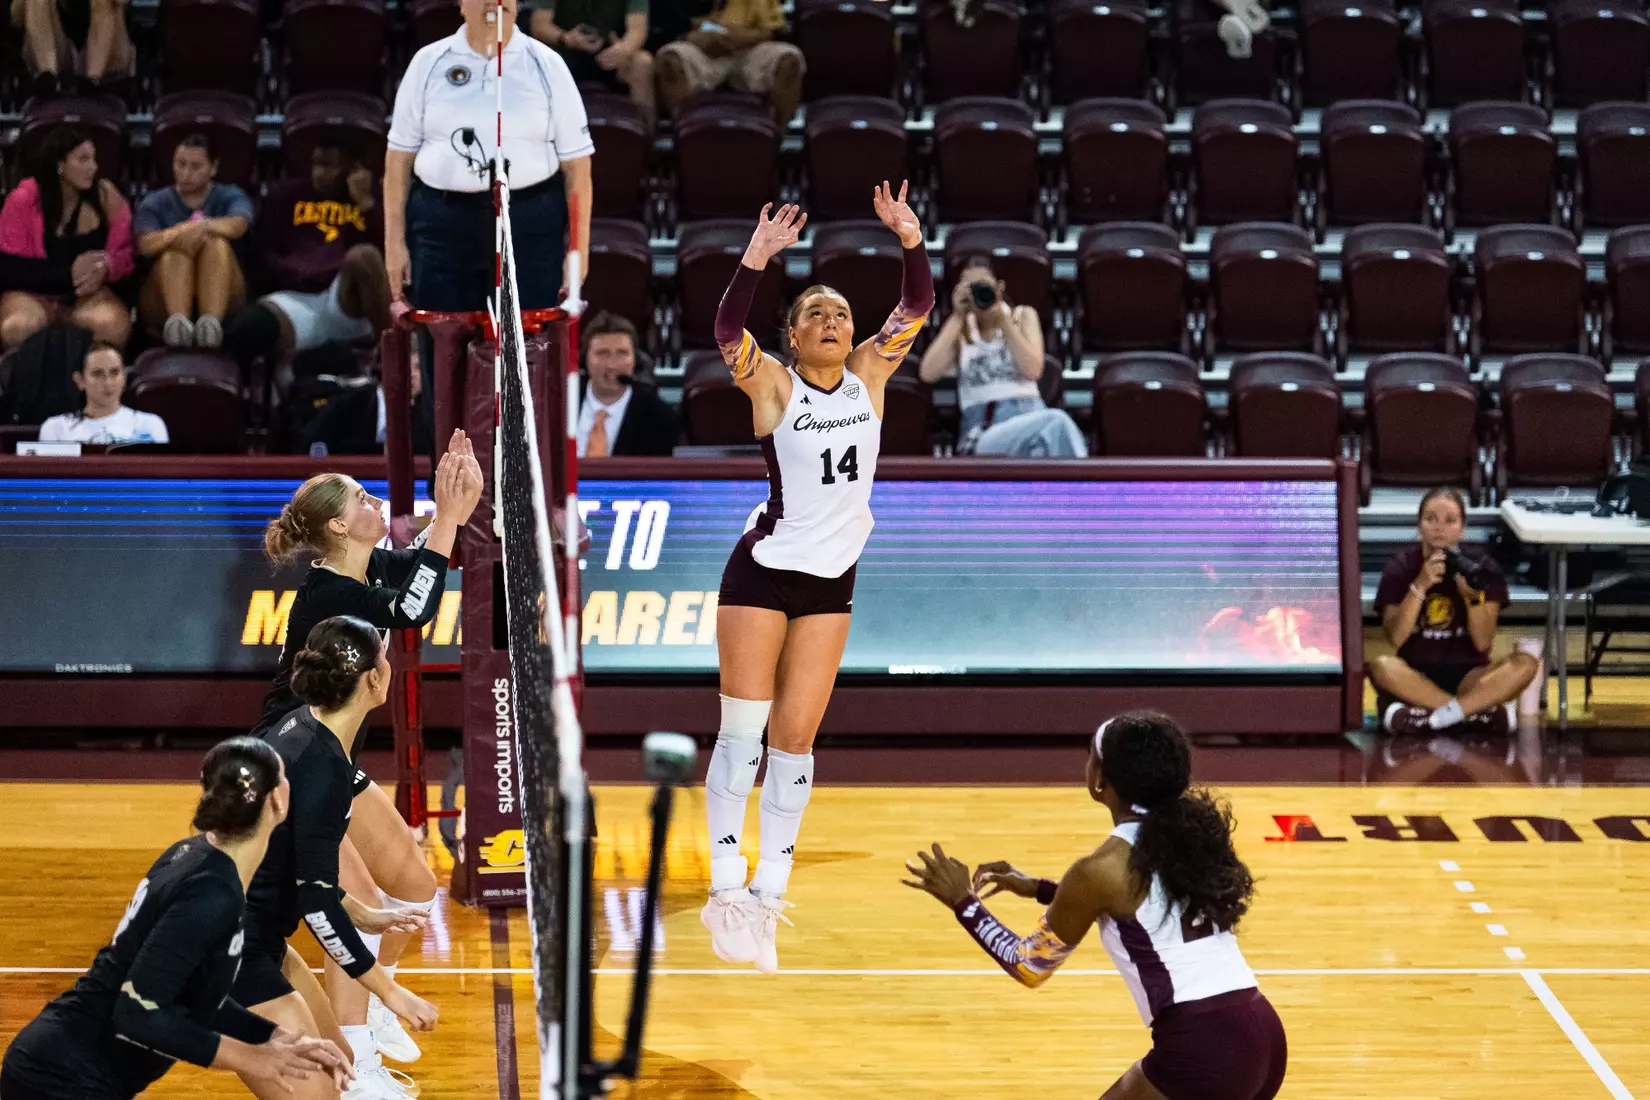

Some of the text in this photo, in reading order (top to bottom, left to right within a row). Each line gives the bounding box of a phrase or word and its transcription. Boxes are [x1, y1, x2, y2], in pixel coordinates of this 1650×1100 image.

[793, 412, 870, 433] Chippewas
[820, 445, 858, 485] 14
[604, 500, 671, 570] TO
[491, 677, 515, 814] sports imports
